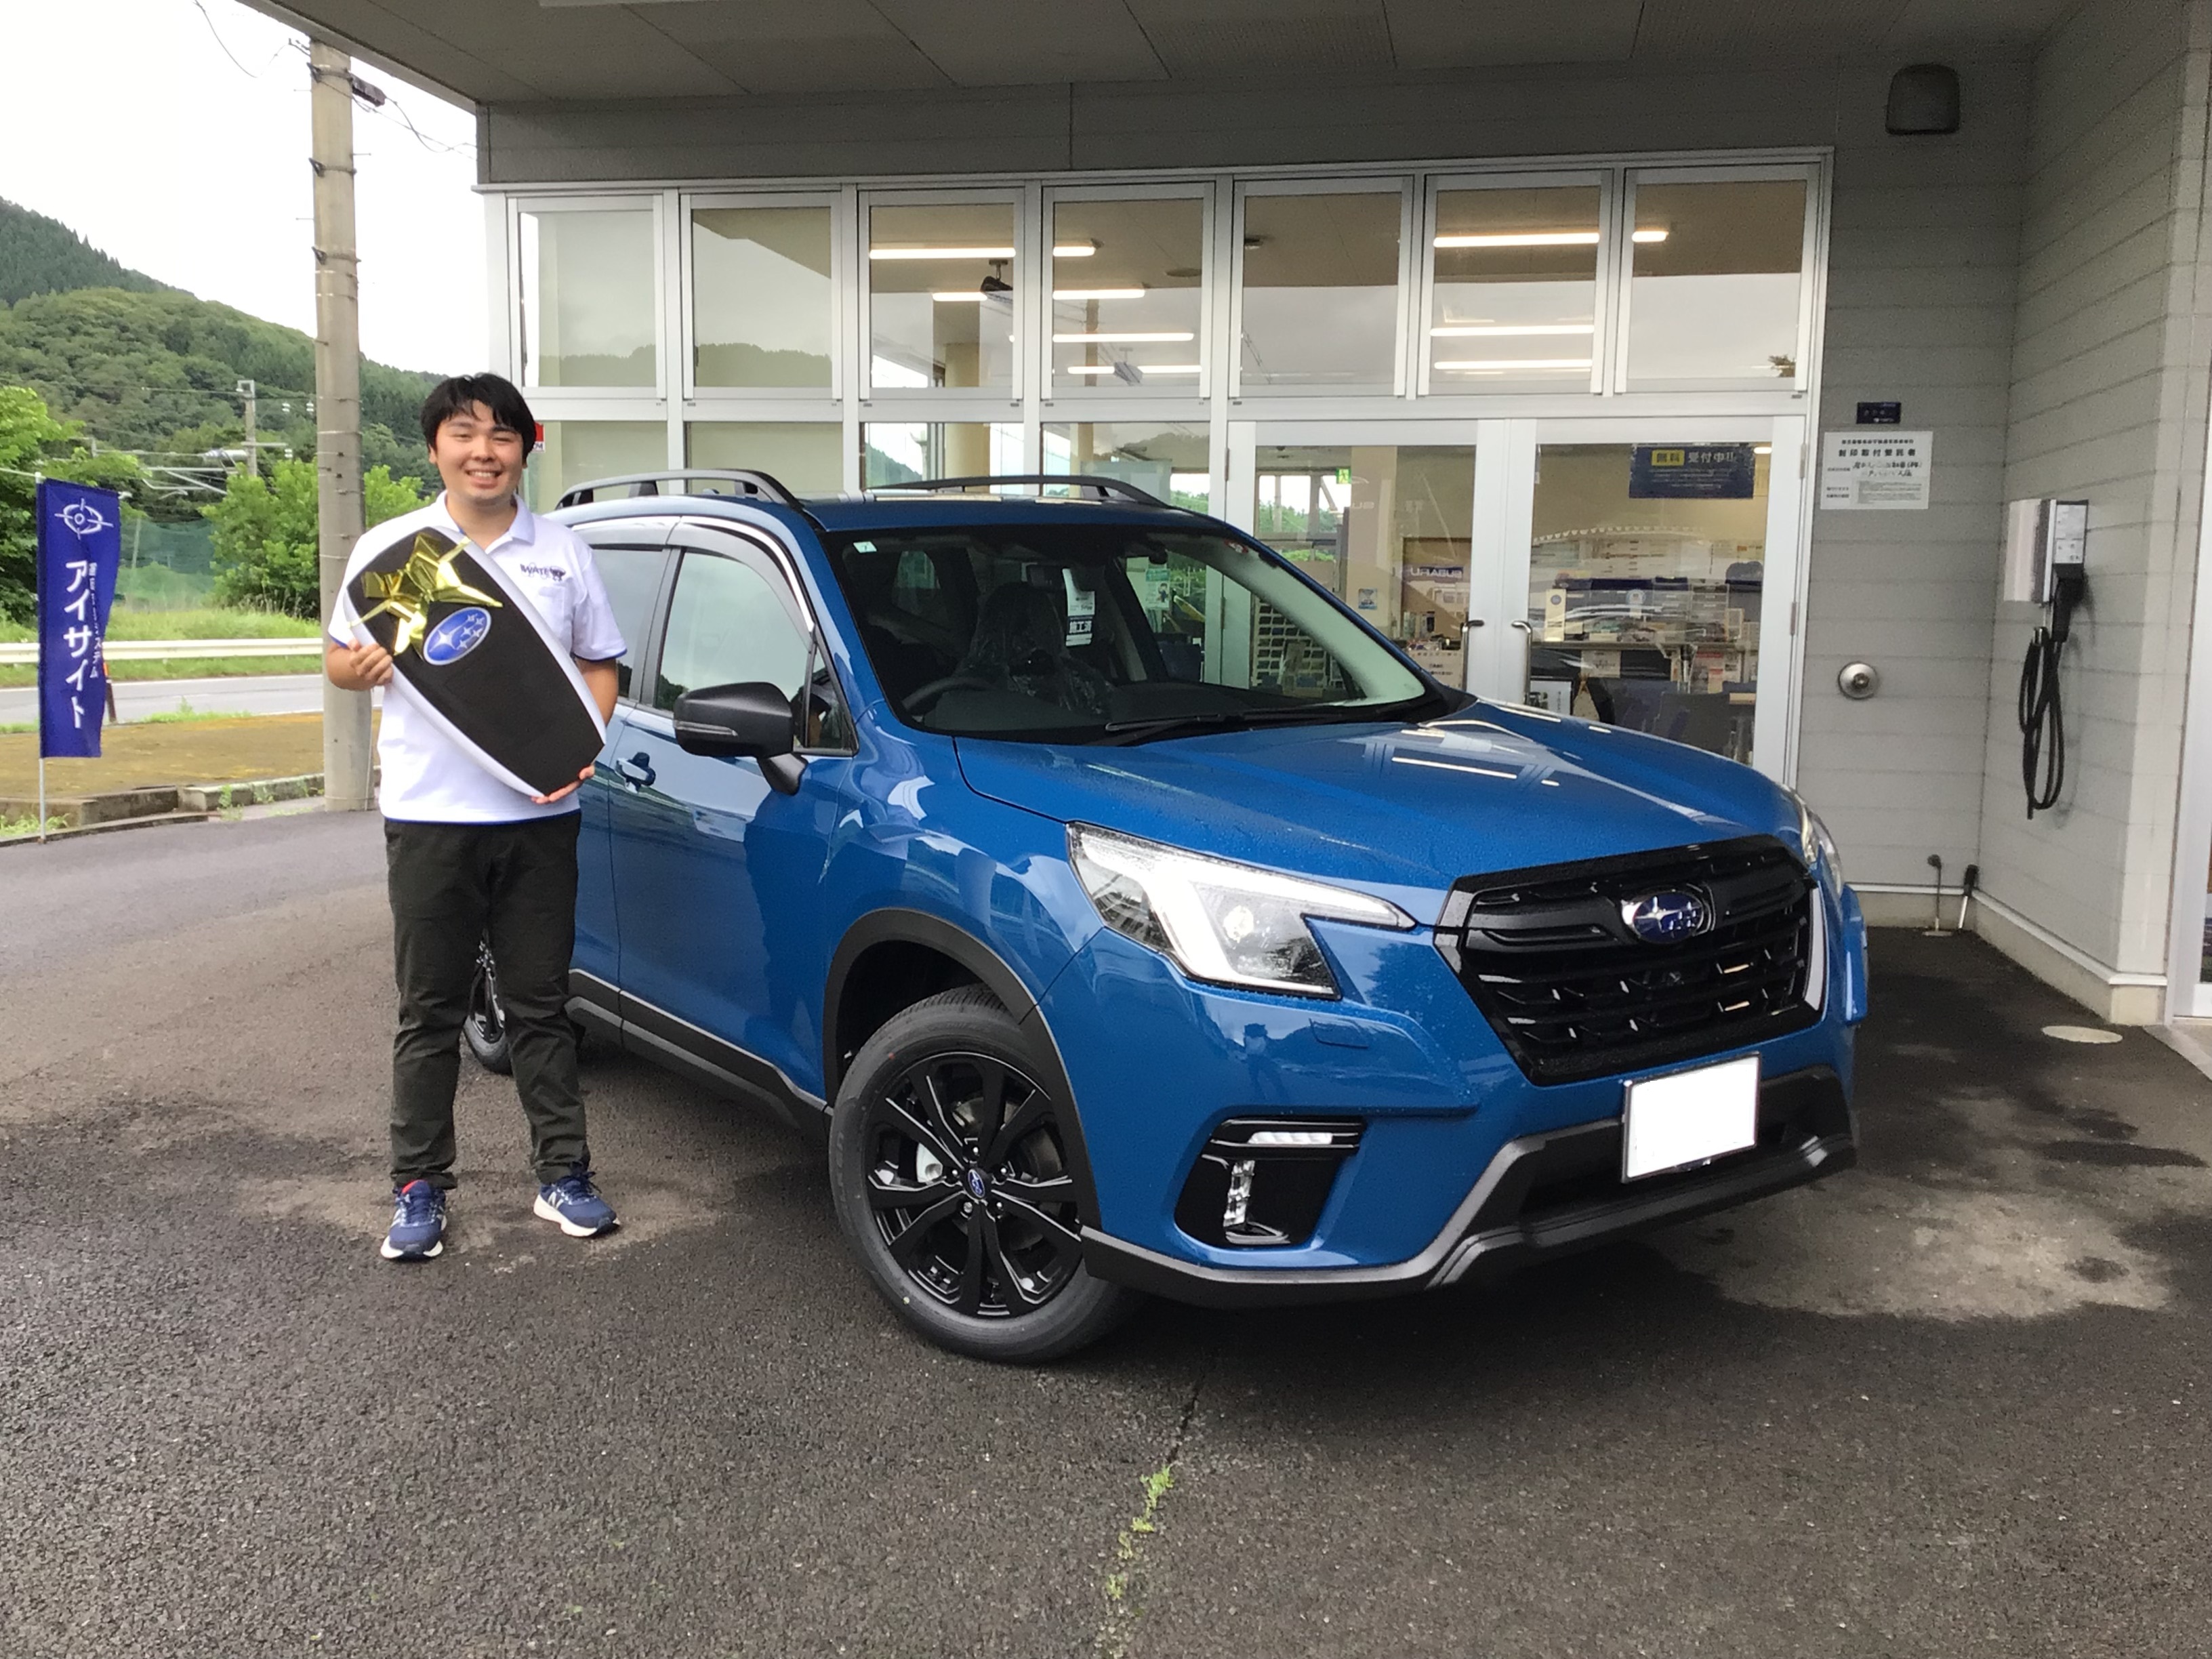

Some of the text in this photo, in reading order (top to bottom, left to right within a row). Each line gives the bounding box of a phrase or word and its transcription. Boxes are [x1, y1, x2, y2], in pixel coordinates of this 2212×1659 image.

[64, 560, 92, 729] アイサイト
